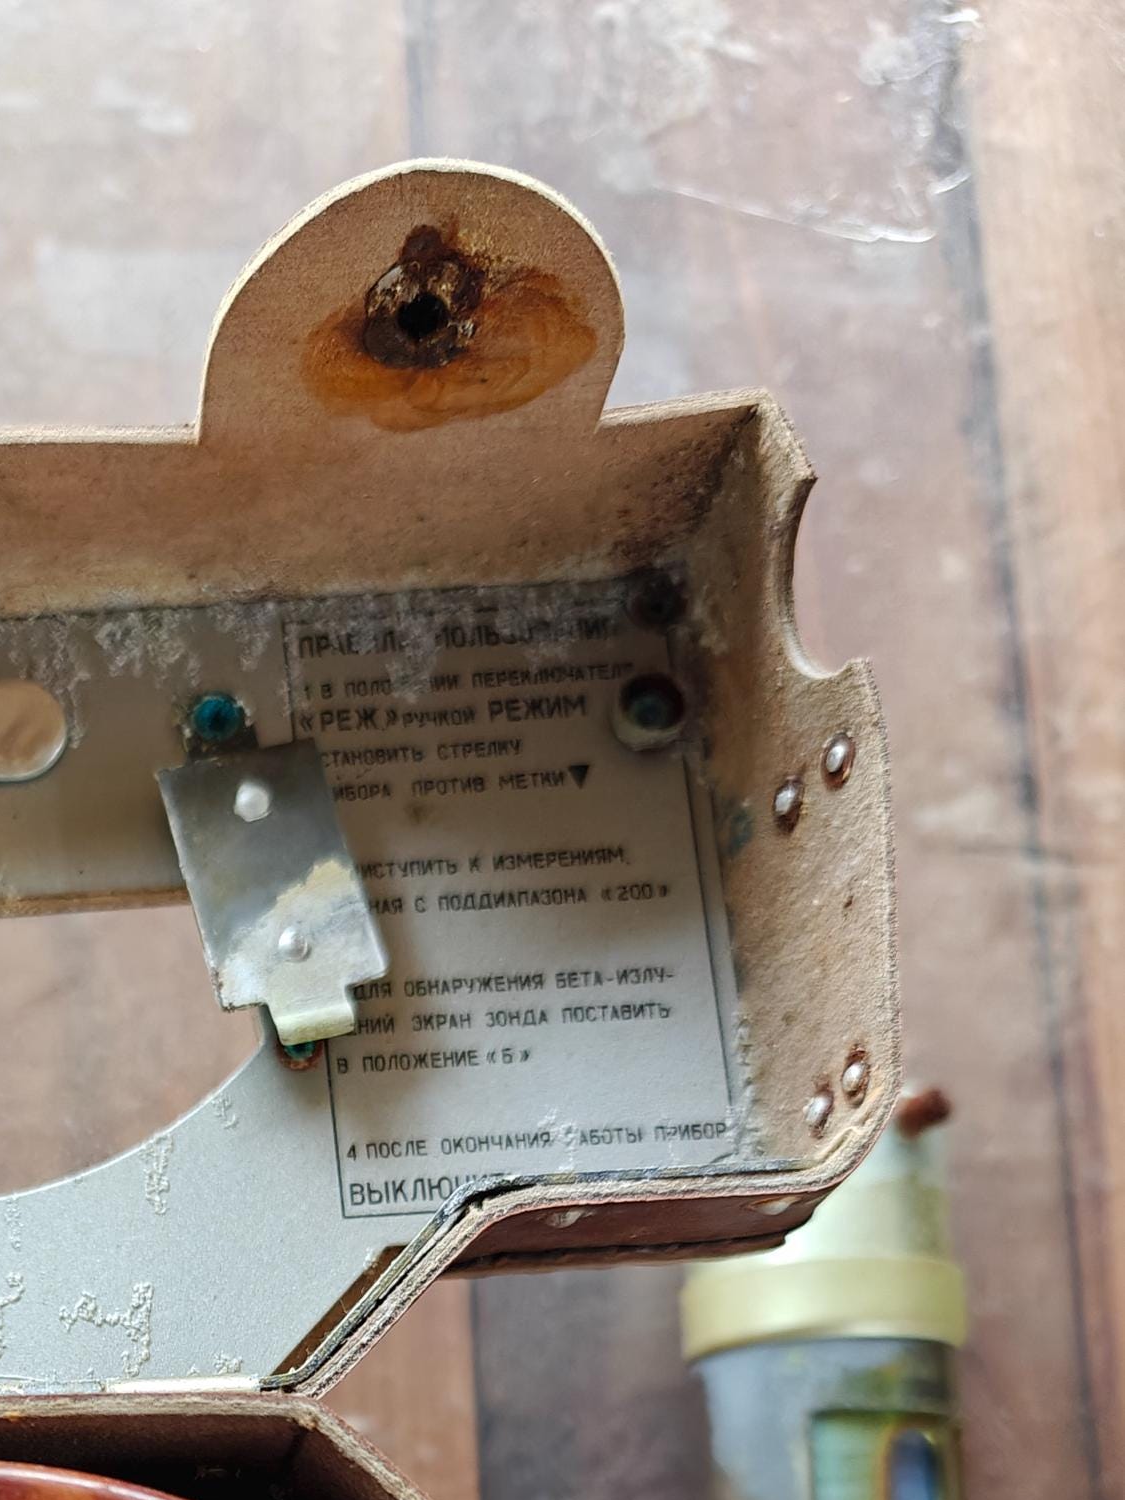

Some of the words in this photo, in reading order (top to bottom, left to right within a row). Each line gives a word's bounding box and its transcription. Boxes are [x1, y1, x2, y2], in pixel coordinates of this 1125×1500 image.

[320, 683, 333, 700] В
[488, 694, 588, 723] РЕЖИМ
[322, 746, 424, 768] СТАНОВИТЬ
[437, 739, 523, 761] СТРЕЛКУ
[332, 783, 391, 801] ИБОРА
[412, 776, 485, 797] ПРОТИВ
[499, 770, 566, 791] МЕТКИ
[359, 859, 458, 880] ИСТУПИТЬ
[468, 857, 482, 874] К
[414, 897, 428, 915] С
[438, 887, 588, 912] ПОДДИАПАЗОНА
[353, 981, 393, 1001] ДЛЯ
[404, 973, 545, 998] ОБНАРУЖЕНИЯ
[556, 966, 674, 991] БЕТА-ИЗЛУ-
[356, 1013, 396, 1035] НИЙ
[411, 1012, 472, 1033] ЭКРАН
[485, 1008, 548, 1029] ЗОНДА
[562, 1001, 671, 1024] ПОСТАВИТЬ
[337, 1057, 349, 1075] В
[363, 1050, 479, 1074] ПОЛОЖЕНИЕ
[346, 1143, 357, 1161] 4
[365, 1140, 428, 1159] ПОСЛЕ
[441, 1131, 551, 1155] ОКОНЧАНИЯ
